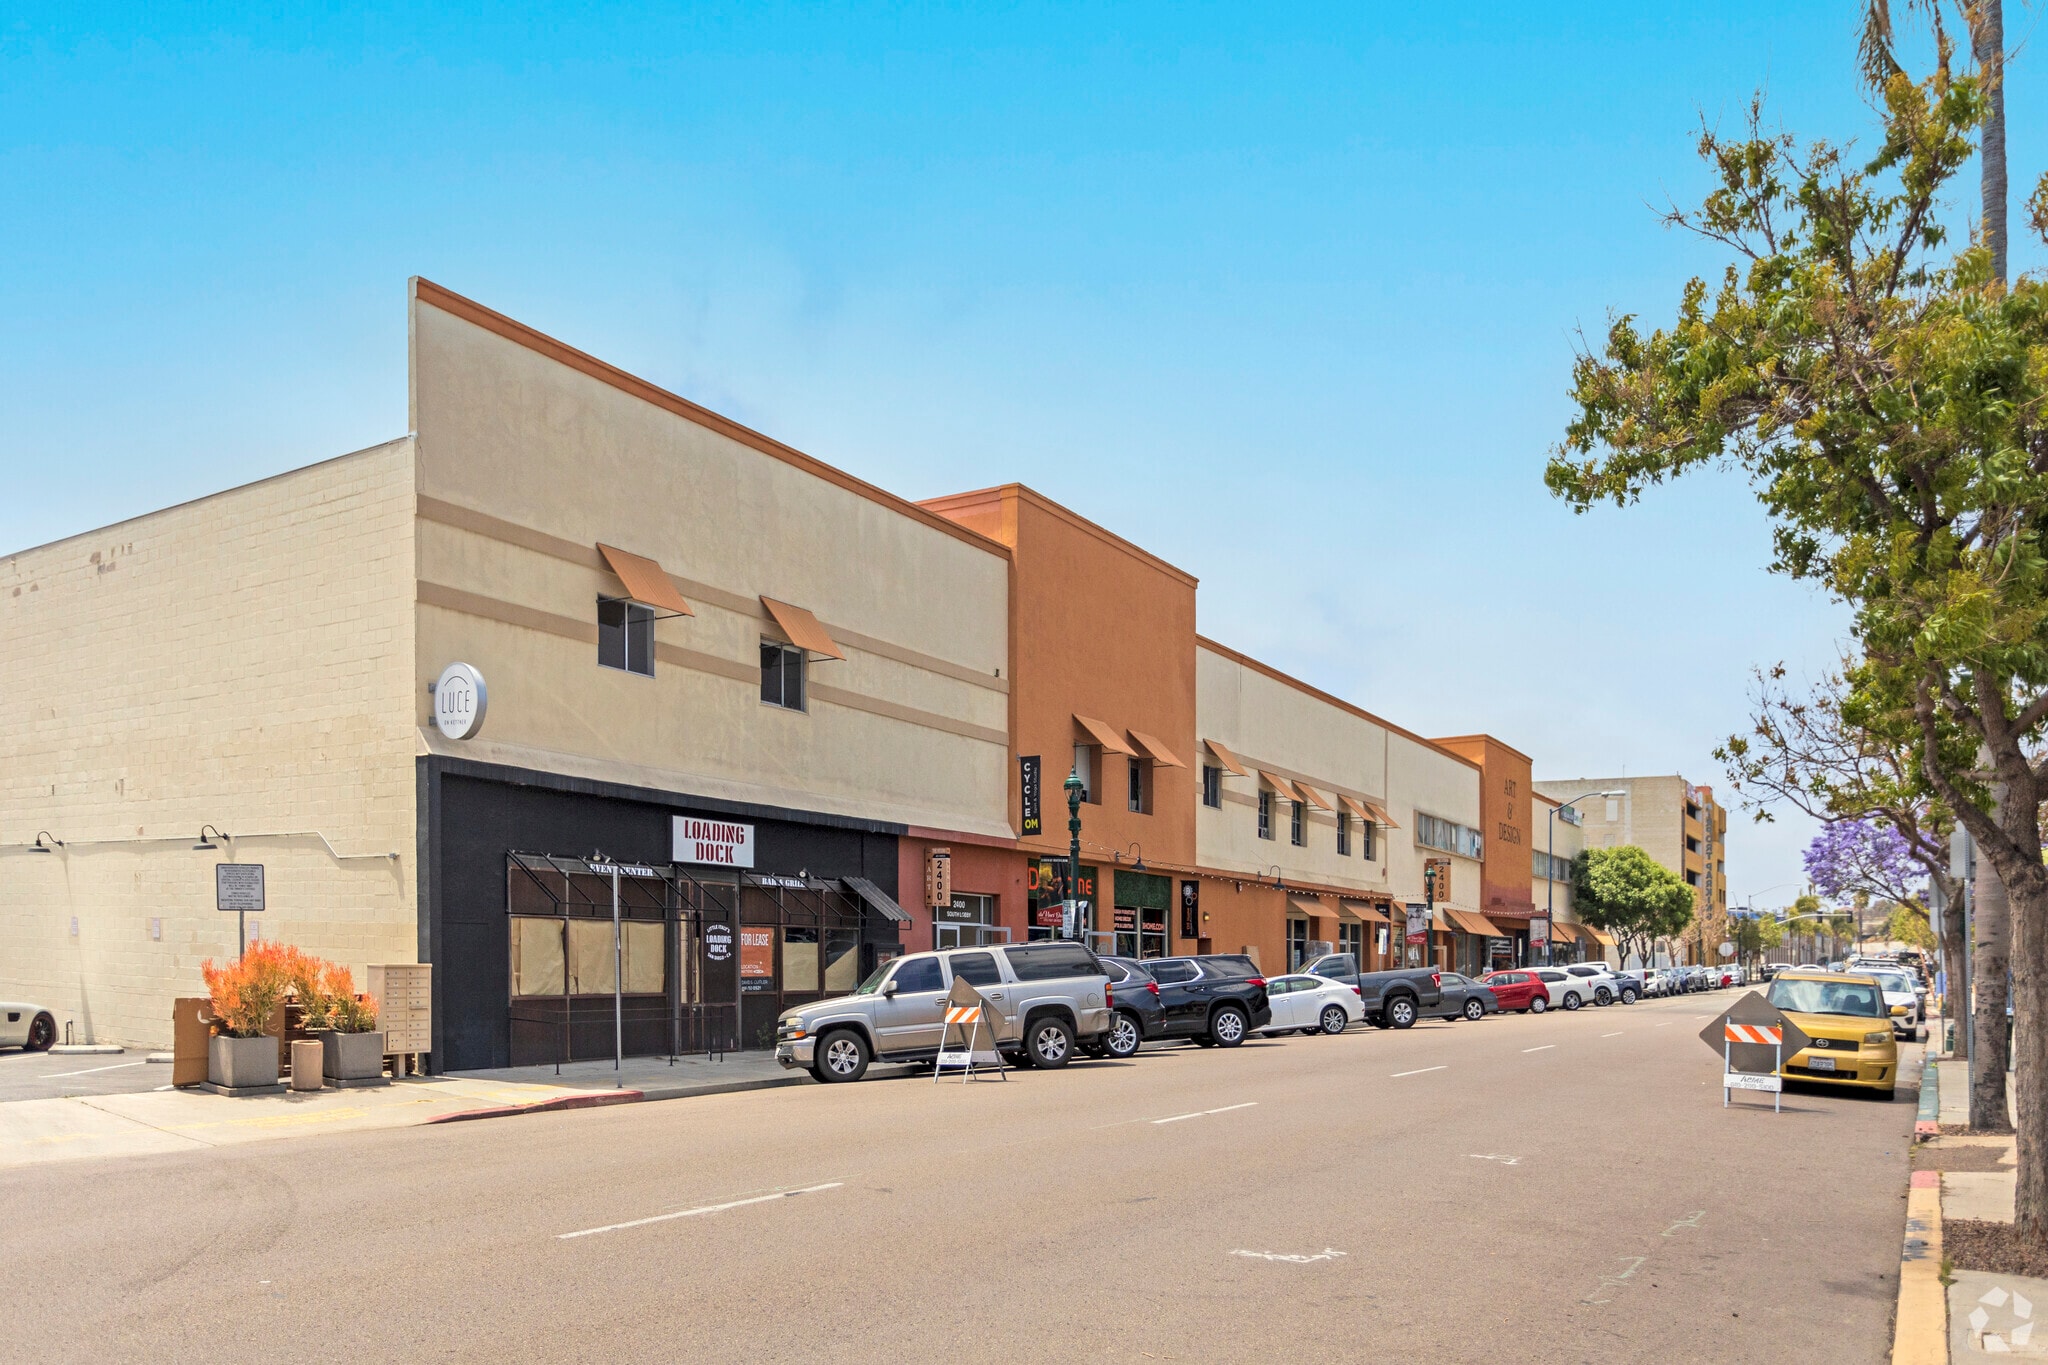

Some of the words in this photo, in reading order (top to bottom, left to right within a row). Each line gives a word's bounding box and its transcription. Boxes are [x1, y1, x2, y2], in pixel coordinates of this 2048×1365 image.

[442, 690, 470, 714] LUCE
[1023, 762, 1031, 817] CYCLE
[1504, 777, 1516, 799] ART
[1024, 818, 1038, 829] OM
[684, 819, 745, 845] LOADING
[1498, 822, 1521, 846] DESIGN
[695, 842, 734, 864] DOCK
[590, 863, 617, 874] EVEN
[953, 901, 966, 909] 2400
[706, 935, 732, 944] LOADING
[741, 933, 752, 946] FOR
[752, 933, 769, 946] LEASE
[710, 944, 727, 953] DOCK
[1740, 1075, 1765, 1084] ACME
